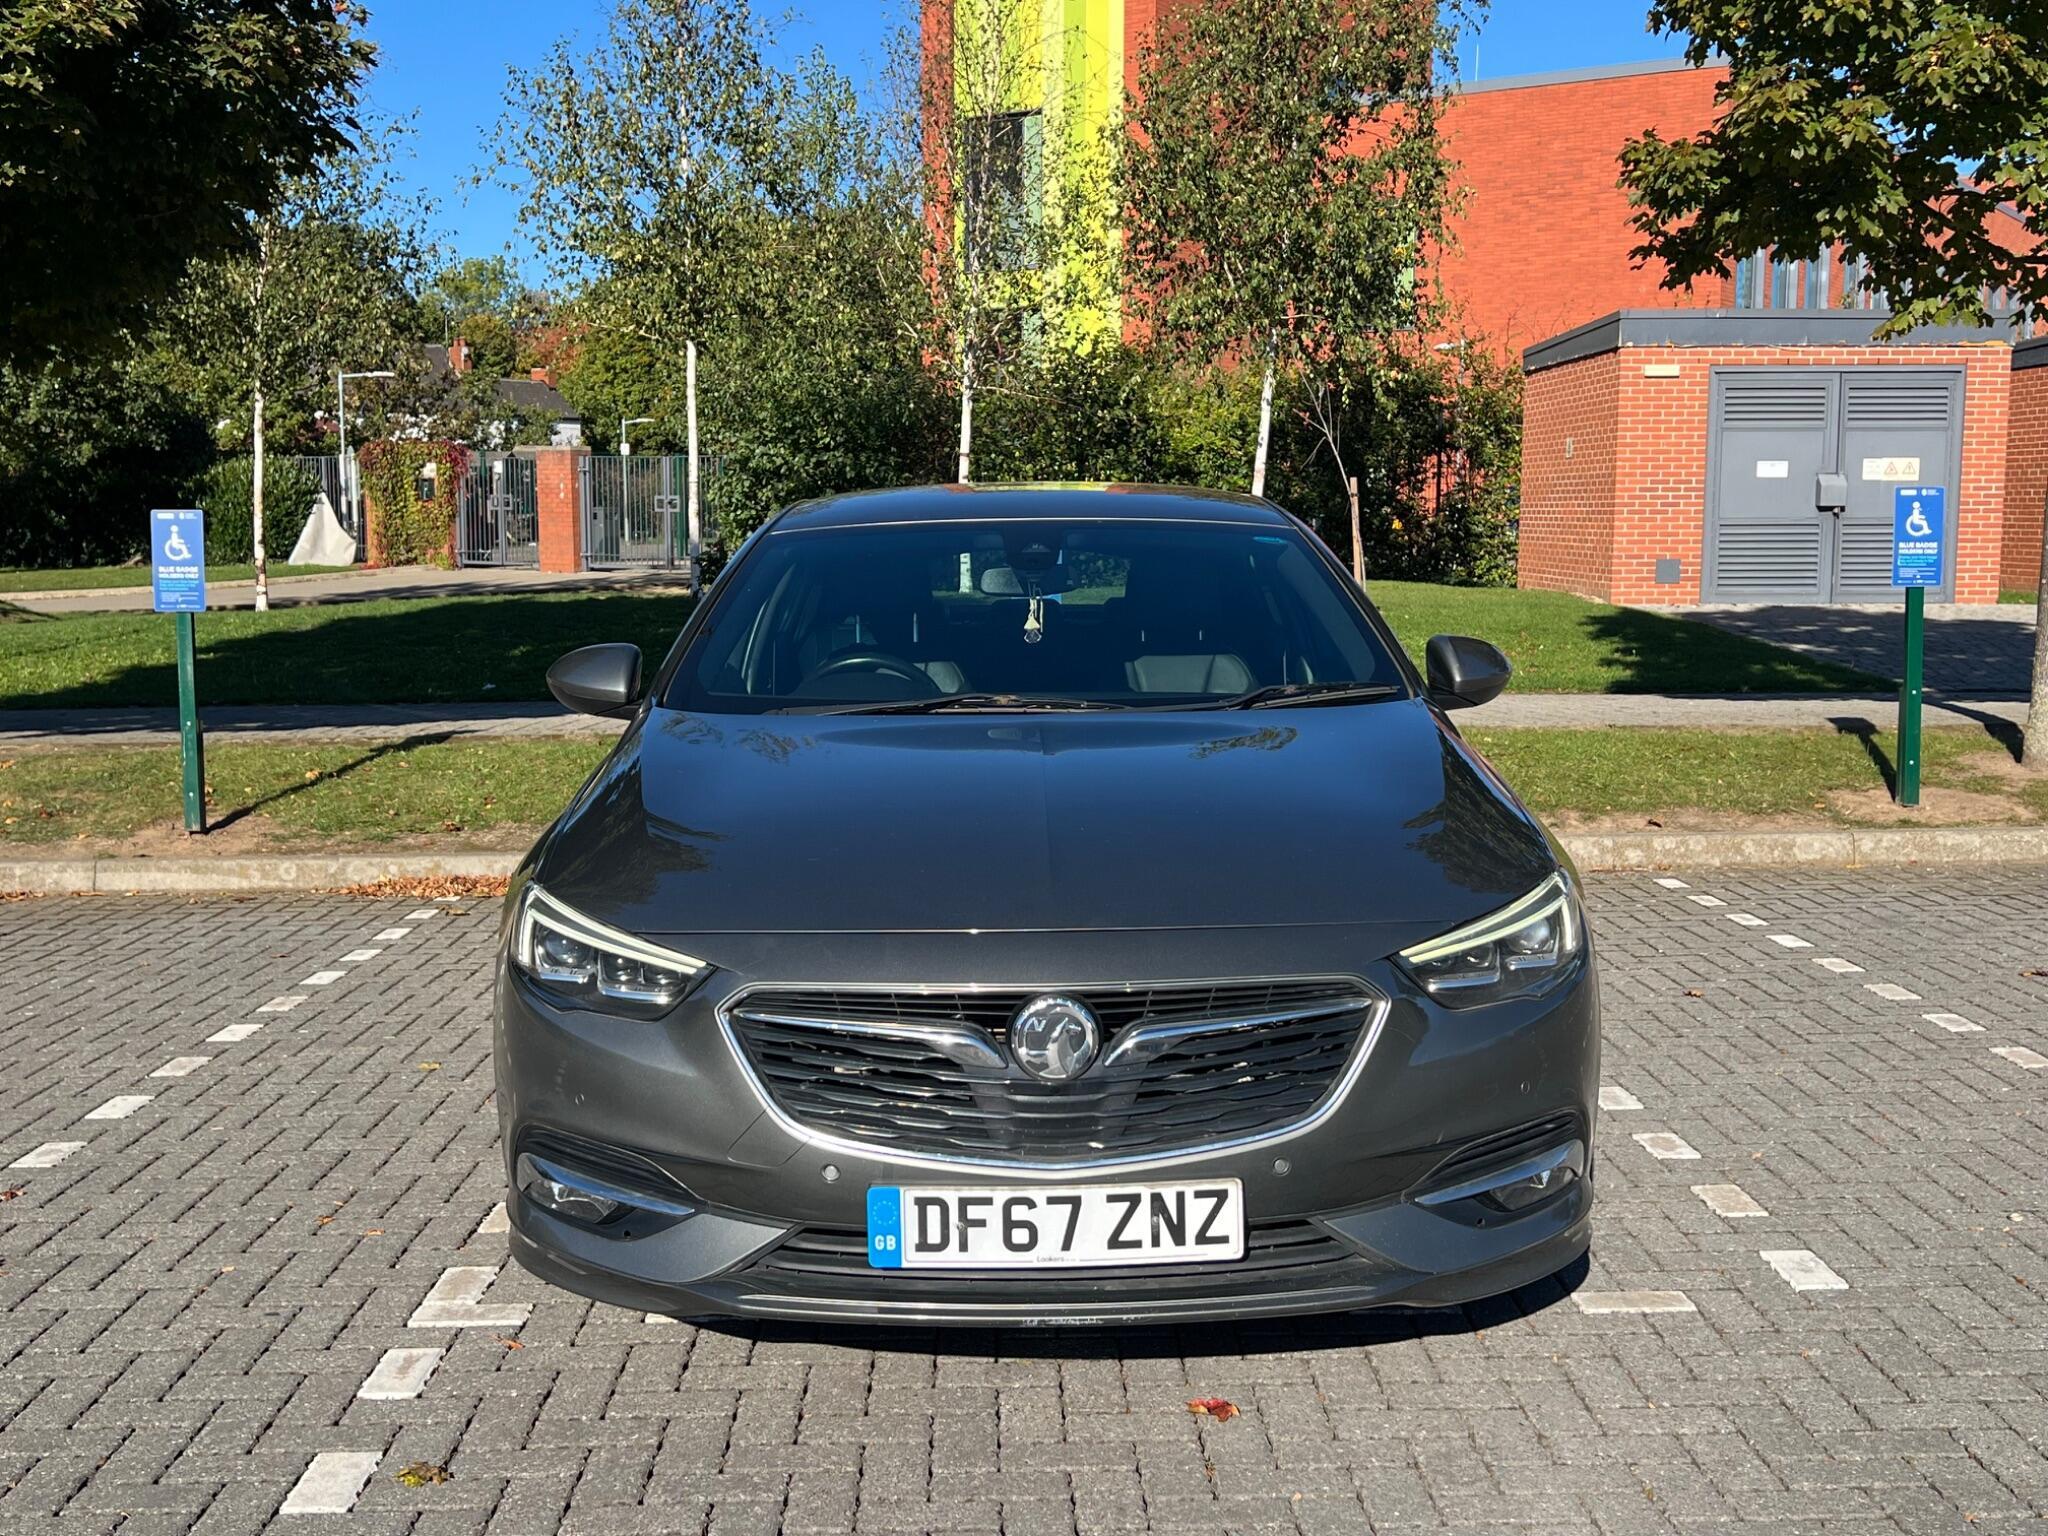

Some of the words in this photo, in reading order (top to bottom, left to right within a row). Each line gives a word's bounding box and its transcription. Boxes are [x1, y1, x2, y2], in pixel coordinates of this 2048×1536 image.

[1899, 541, 1915, 549] BLUE
[1916, 541, 1938, 549] BADGE
[914, 1194, 1083, 1254] DF67
[1106, 1188, 1231, 1250] ZNZ
[874, 1235, 897, 1251] GB
